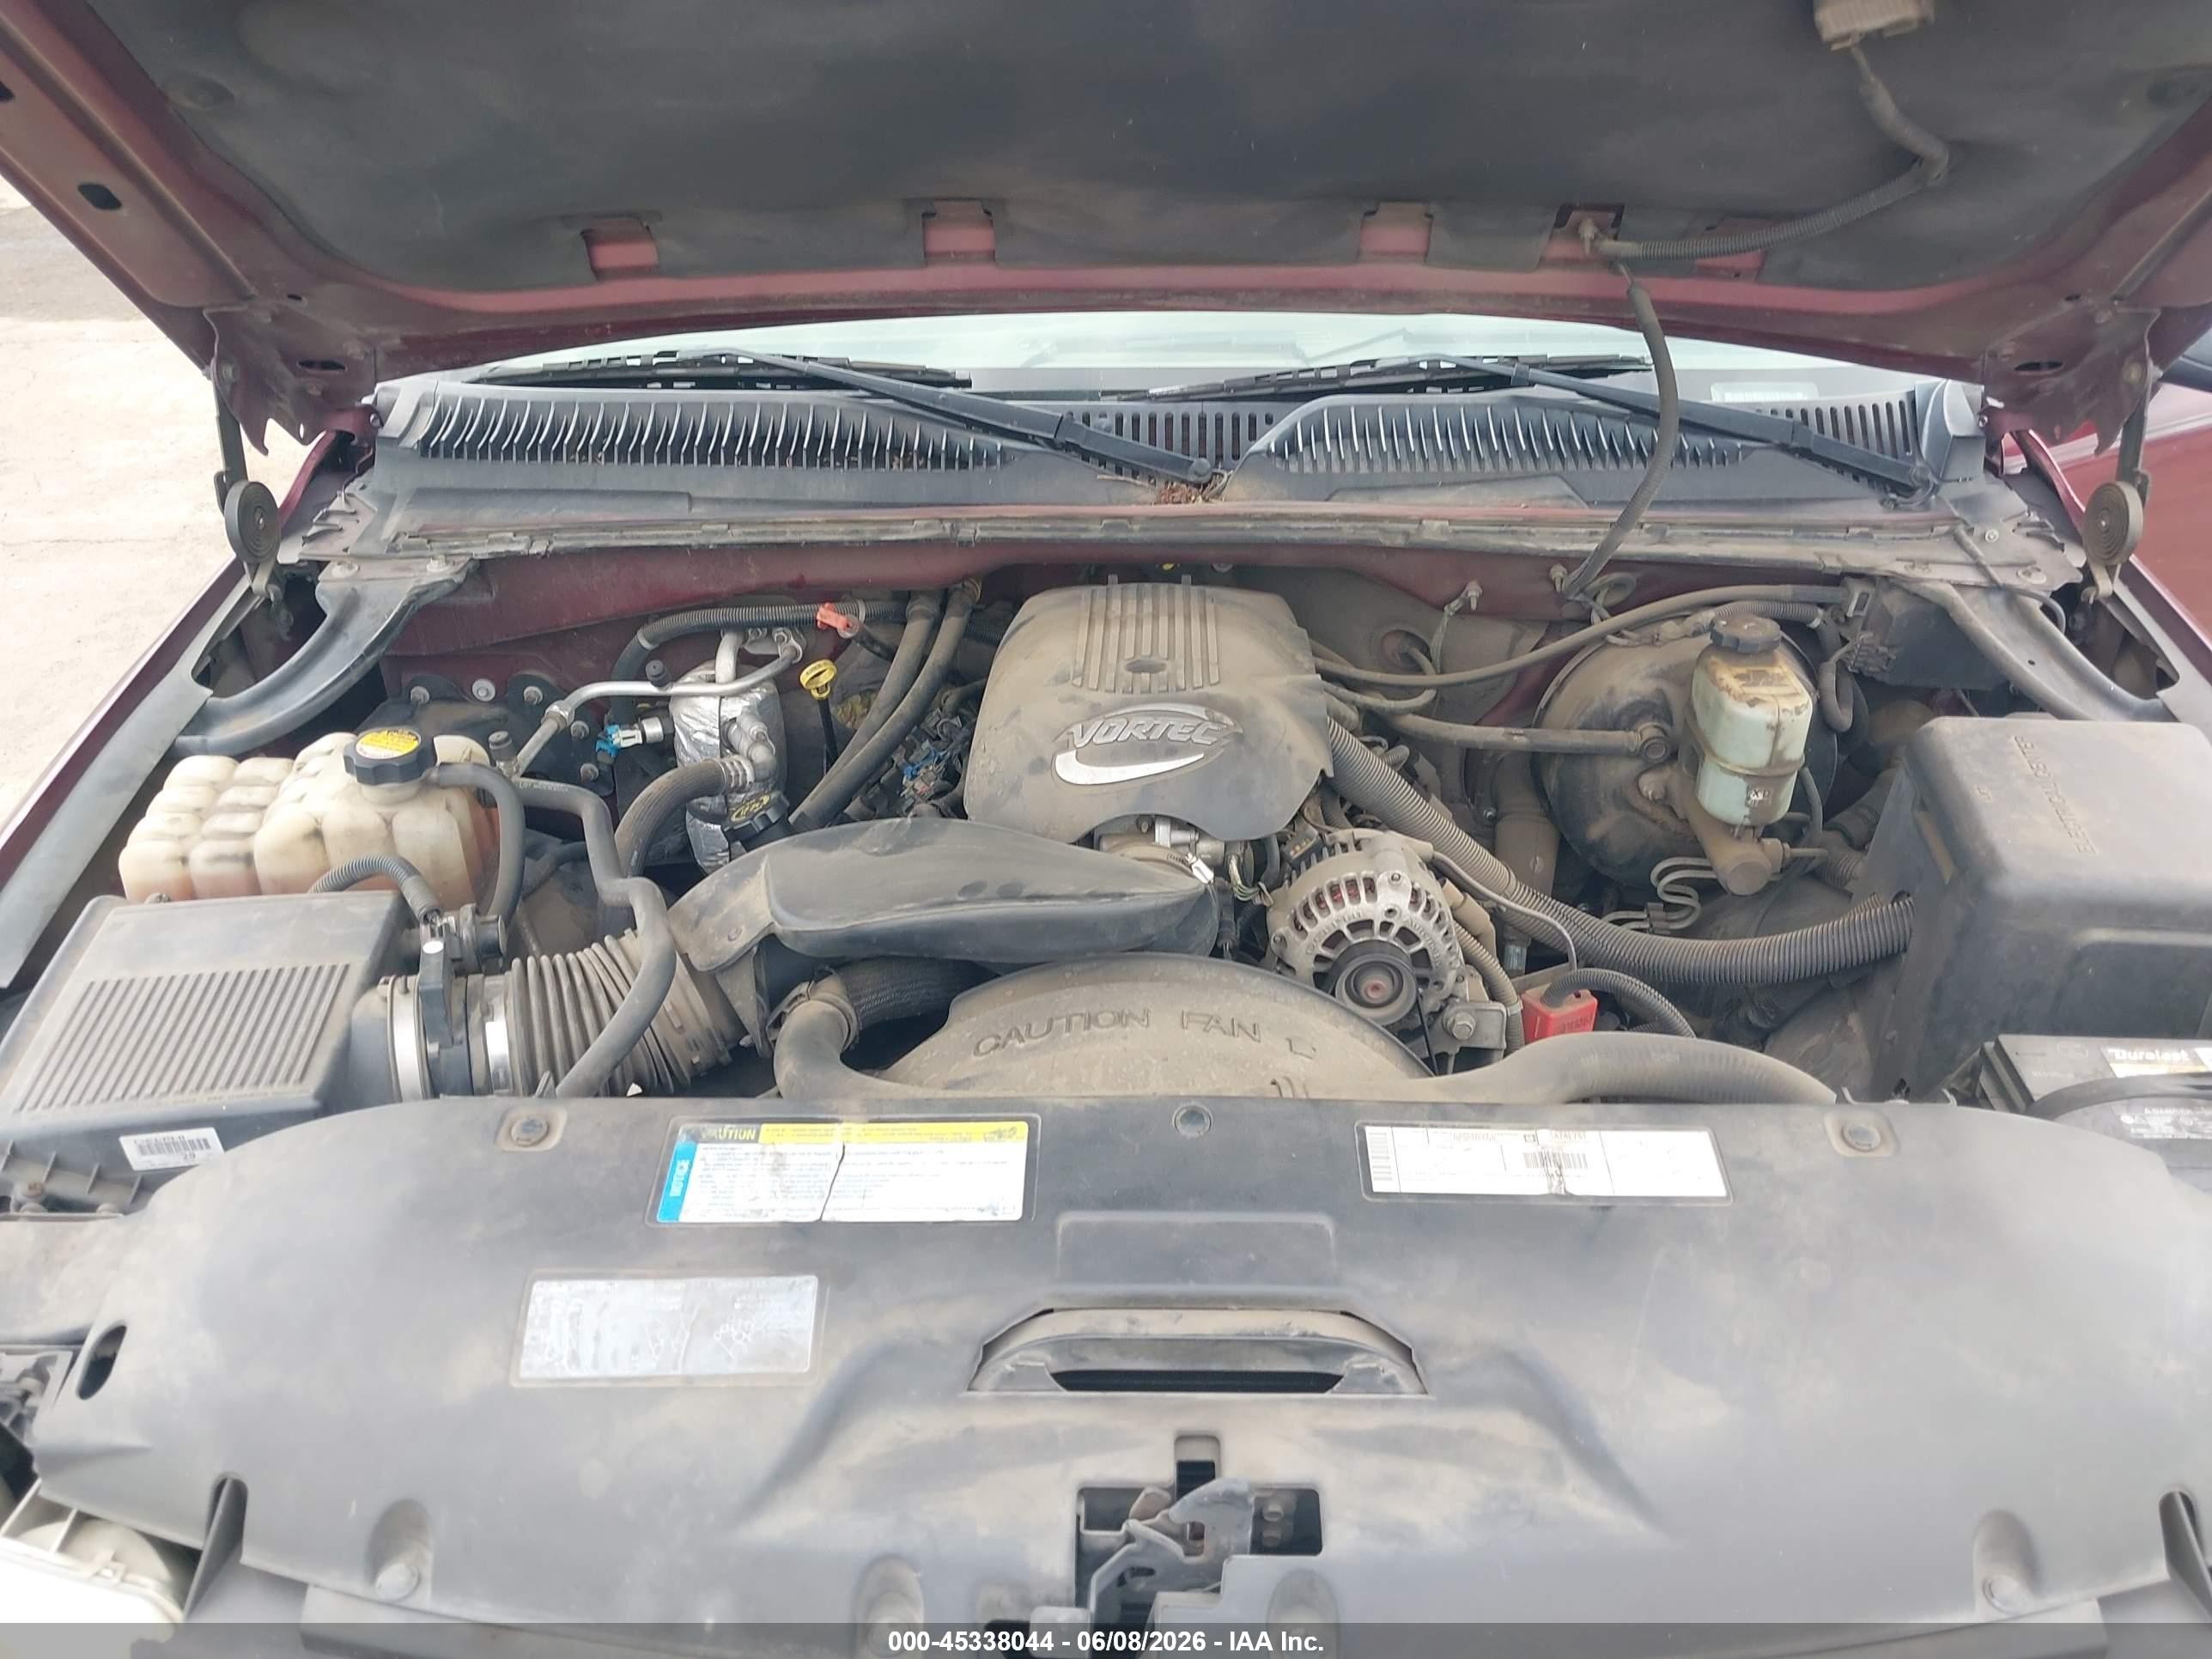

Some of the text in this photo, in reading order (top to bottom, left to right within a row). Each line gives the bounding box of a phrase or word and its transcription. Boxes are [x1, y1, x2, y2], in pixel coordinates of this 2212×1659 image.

[1068, 716, 1224, 748] VORTEC
[973, 1008, 1151, 1057] CAUTION
[1182, 1010, 1261, 1043] FAN
